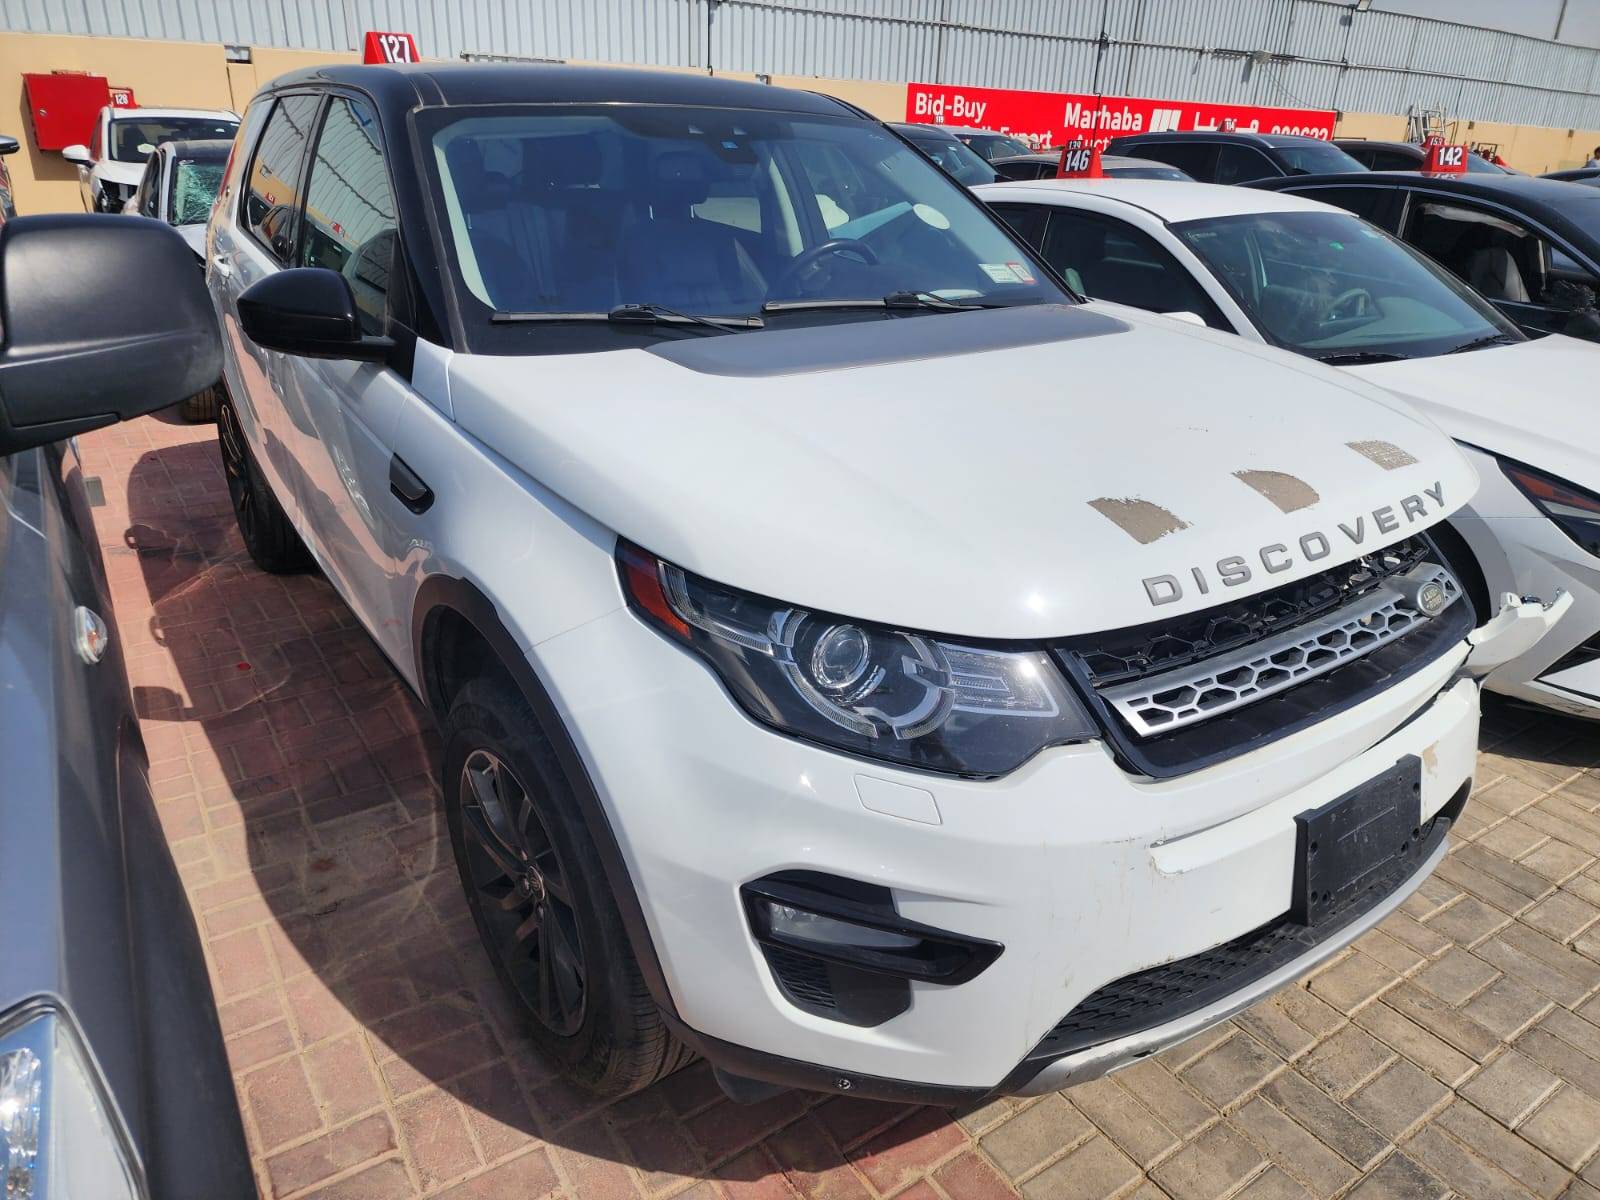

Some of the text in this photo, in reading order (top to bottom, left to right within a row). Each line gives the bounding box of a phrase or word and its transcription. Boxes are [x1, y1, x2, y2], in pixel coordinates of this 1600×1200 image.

[380, 35, 411, 63] 127
[915, 92, 986, 124] Bid-Buy
[1064, 102, 1143, 131] Marhaba
[1065, 150, 1091, 172] 146
[1439, 147, 1463, 166] 142
[1142, 481, 1446, 606] DISCOVERY
